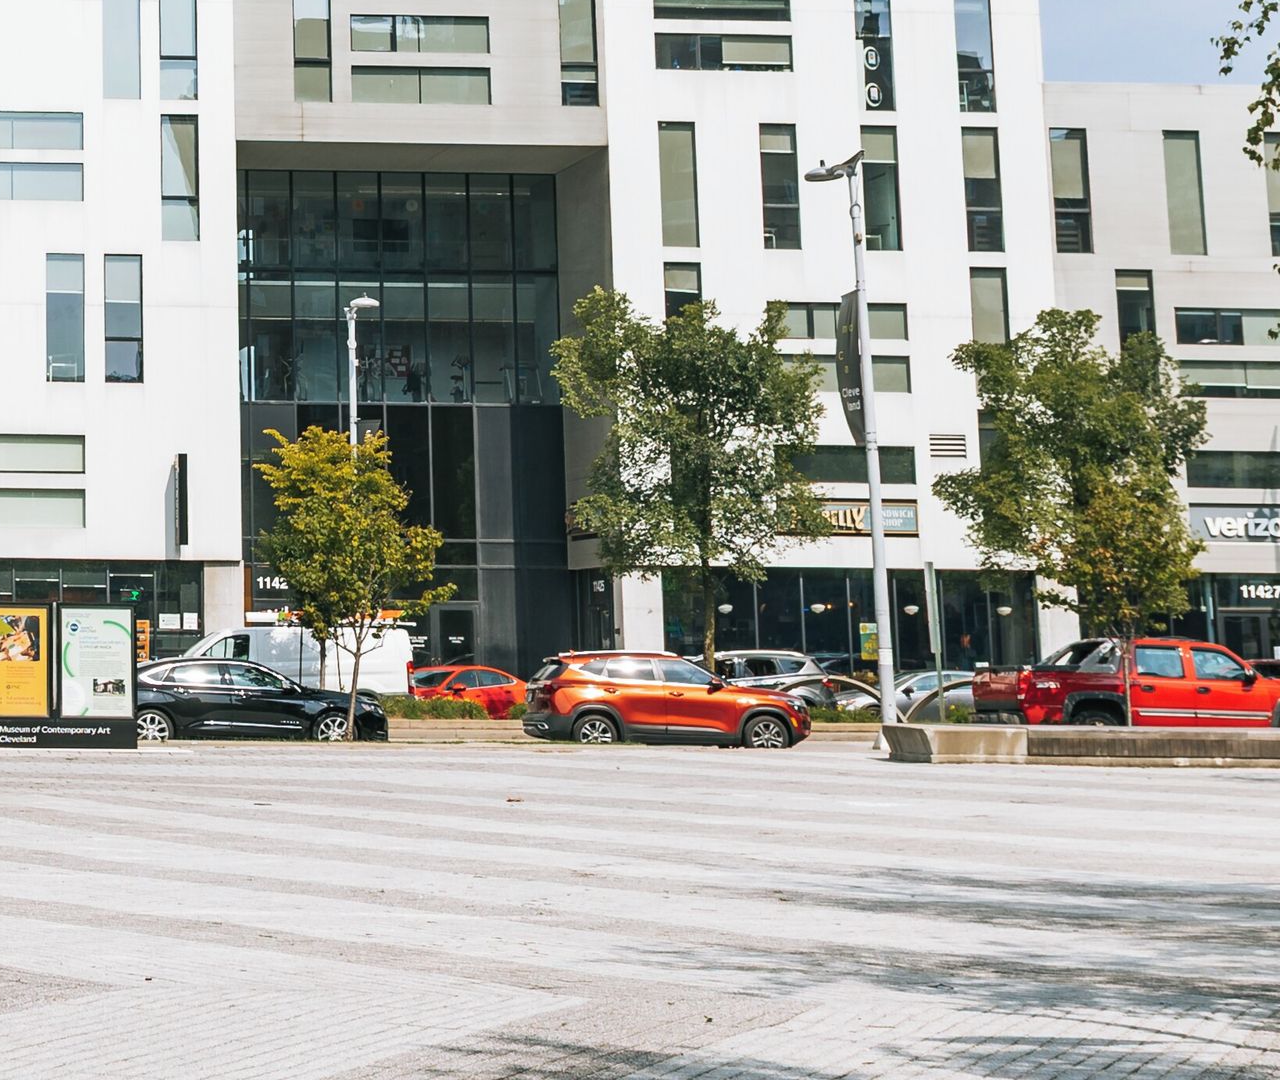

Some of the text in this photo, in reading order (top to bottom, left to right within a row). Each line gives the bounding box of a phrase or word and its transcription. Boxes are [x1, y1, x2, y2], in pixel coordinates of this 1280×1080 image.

[842, 387, 860, 397] Cleve
[847, 401, 860, 411] land
[881, 509, 914, 518] NDWICH
[1240, 584, 1280, 599] 11427
[31, 725, 40, 734] of
[41, 726, 97, 736] Contemporary
[97, 726, 111, 734] Art
[0, 735, 37, 743] Cleveland
